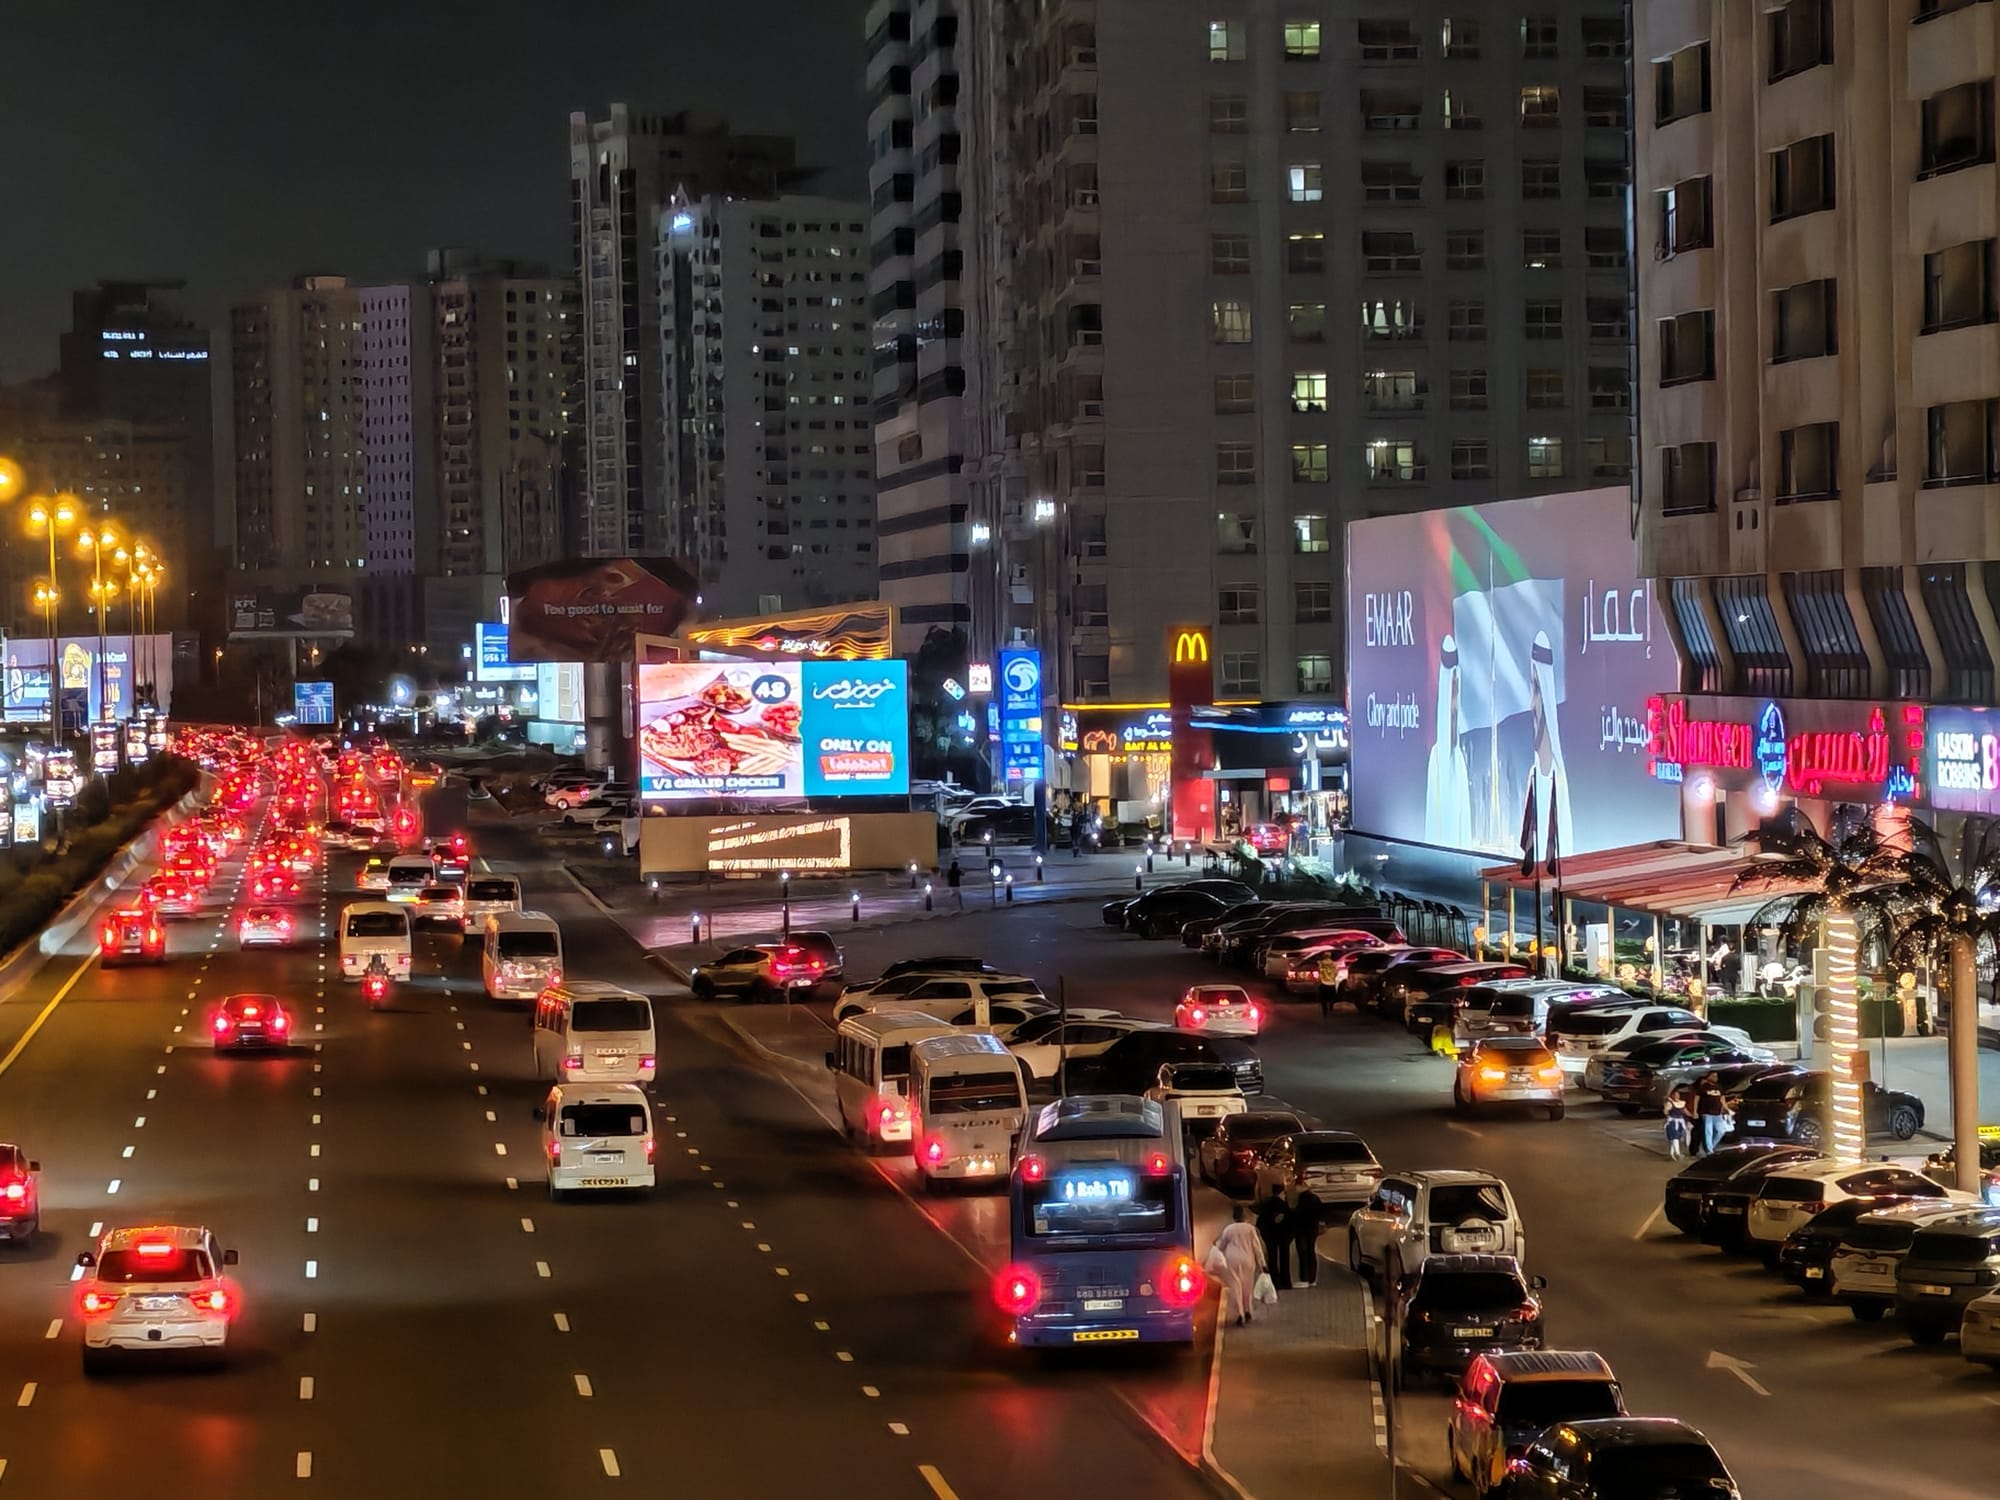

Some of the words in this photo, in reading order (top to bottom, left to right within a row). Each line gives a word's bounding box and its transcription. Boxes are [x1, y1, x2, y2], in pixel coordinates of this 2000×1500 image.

[235, 600, 257, 609] KFC
[543, 604, 565, 615] Too
[567, 604, 599, 617] good
[601, 604, 614, 614] to
[617, 603, 644, 614] wait
[646, 603, 664, 614] for
[1366, 591, 1415, 647] EMAAR
[1582, 579, 1651, 659] إعمار
[755, 681, 787, 699] 48
[1367, 692, 1386, 739] Glory
[1387, 692, 1400, 729] and
[1401, 692, 1419, 740] pride
[820, 738, 864, 752] ONLY
[866, 740, 892, 752] ON
